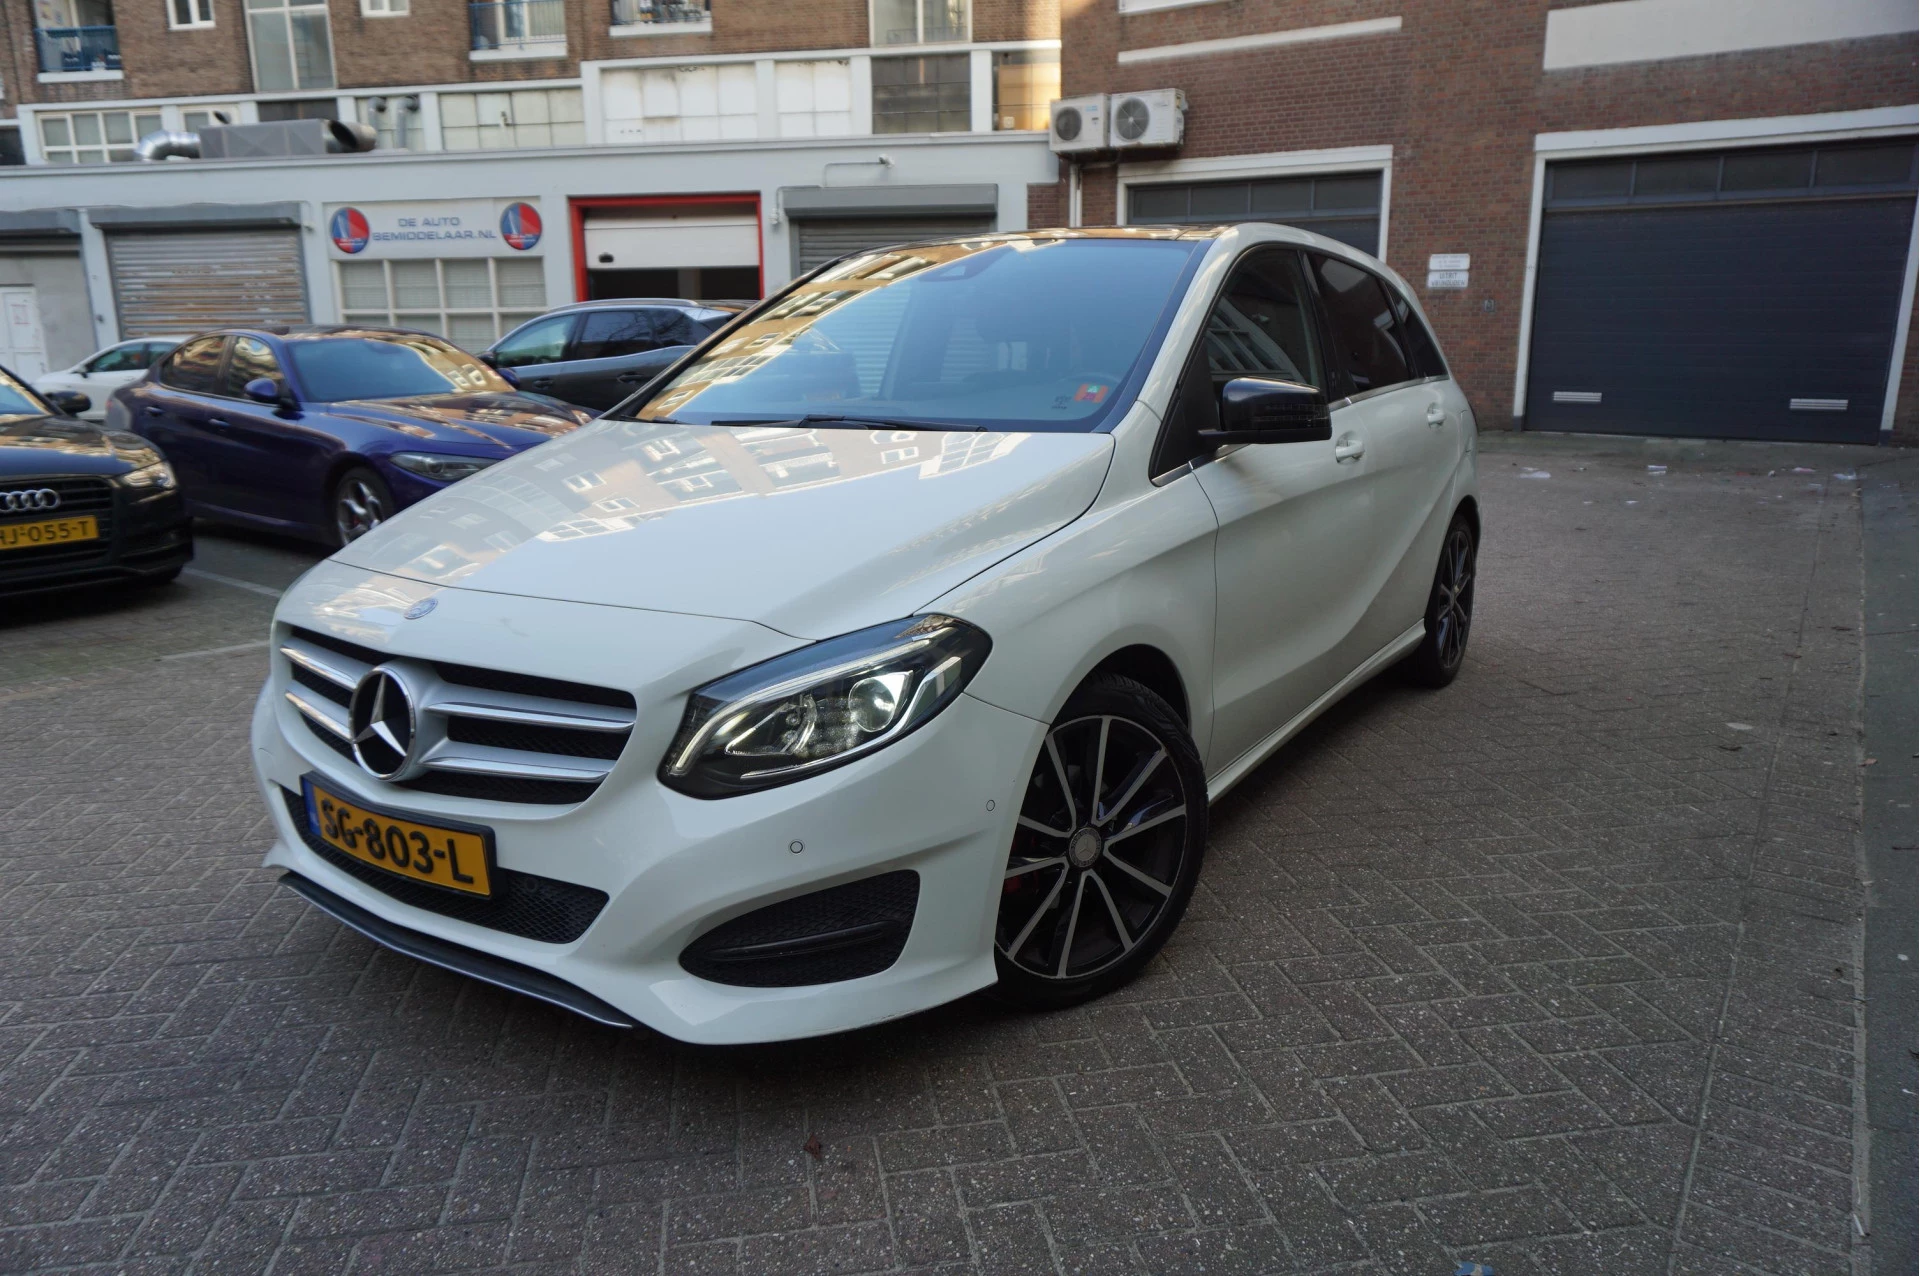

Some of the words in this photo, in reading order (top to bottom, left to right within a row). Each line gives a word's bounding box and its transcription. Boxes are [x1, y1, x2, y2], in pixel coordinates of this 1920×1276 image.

[398, 217, 417, 227] DE
[422, 216, 461, 227] AUTO
[372, 230, 497, 241] BEMIDDELAAR.NL
[321, 798, 474, 884] SG-803-L
